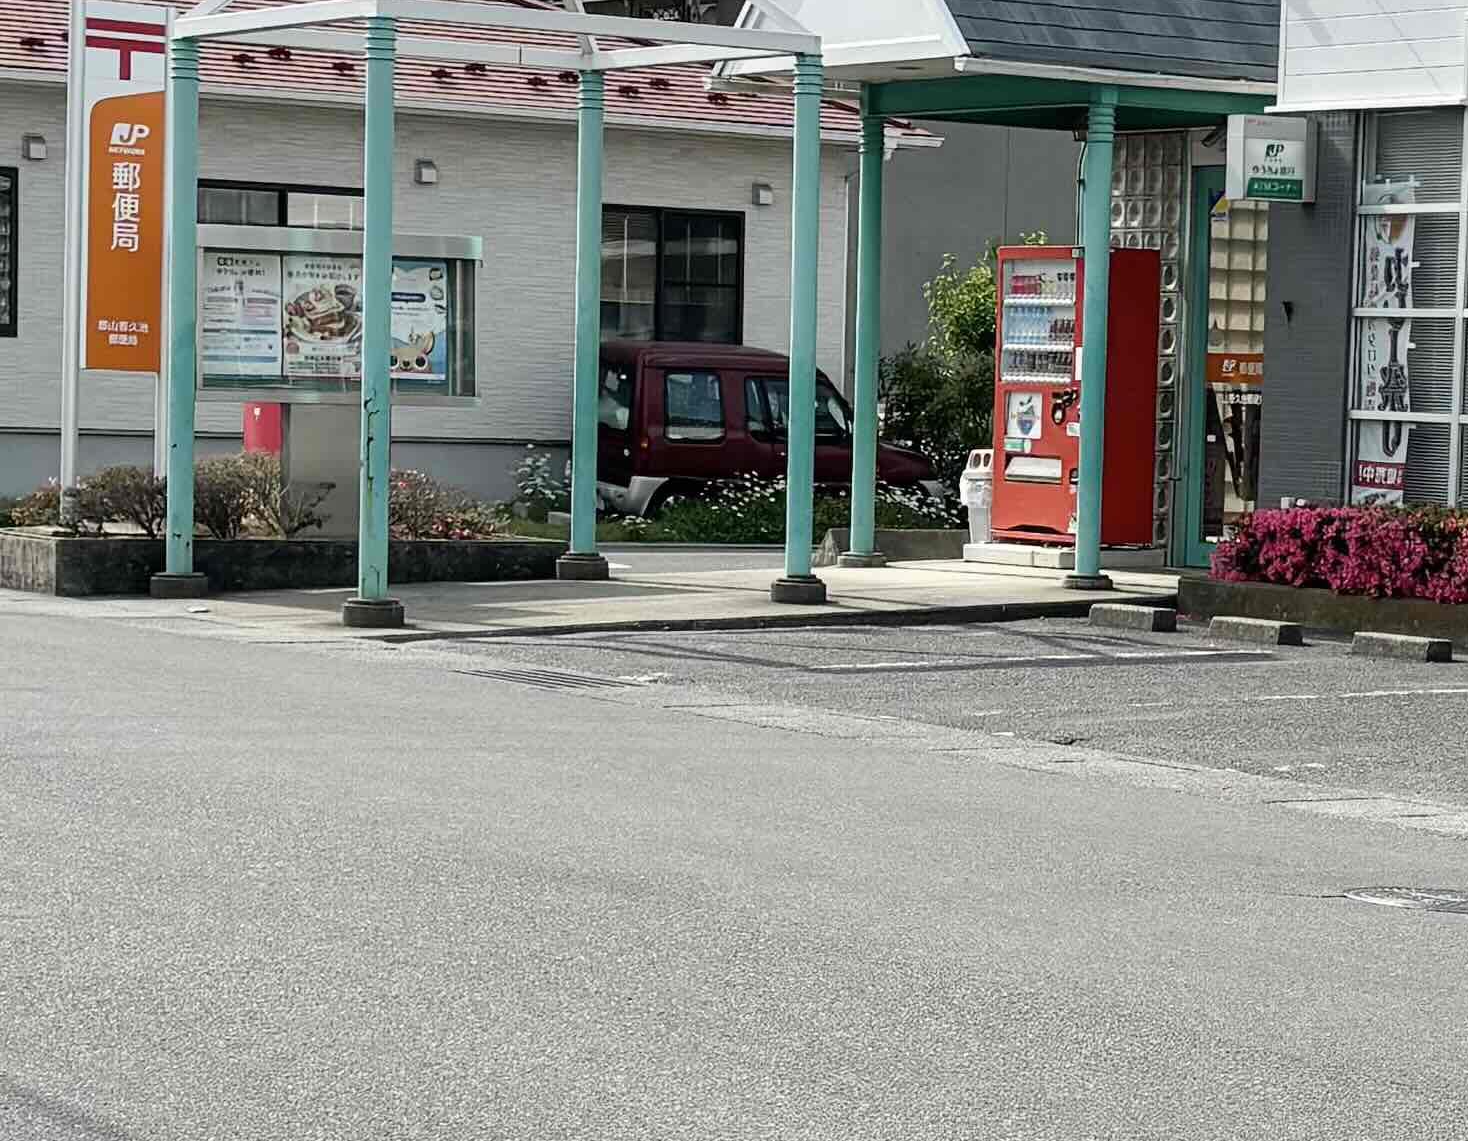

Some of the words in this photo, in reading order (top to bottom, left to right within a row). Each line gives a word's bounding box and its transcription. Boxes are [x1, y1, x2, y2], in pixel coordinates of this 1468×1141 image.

[110, 122, 151, 145] JP
[111, 161, 141, 252] 郵便局
